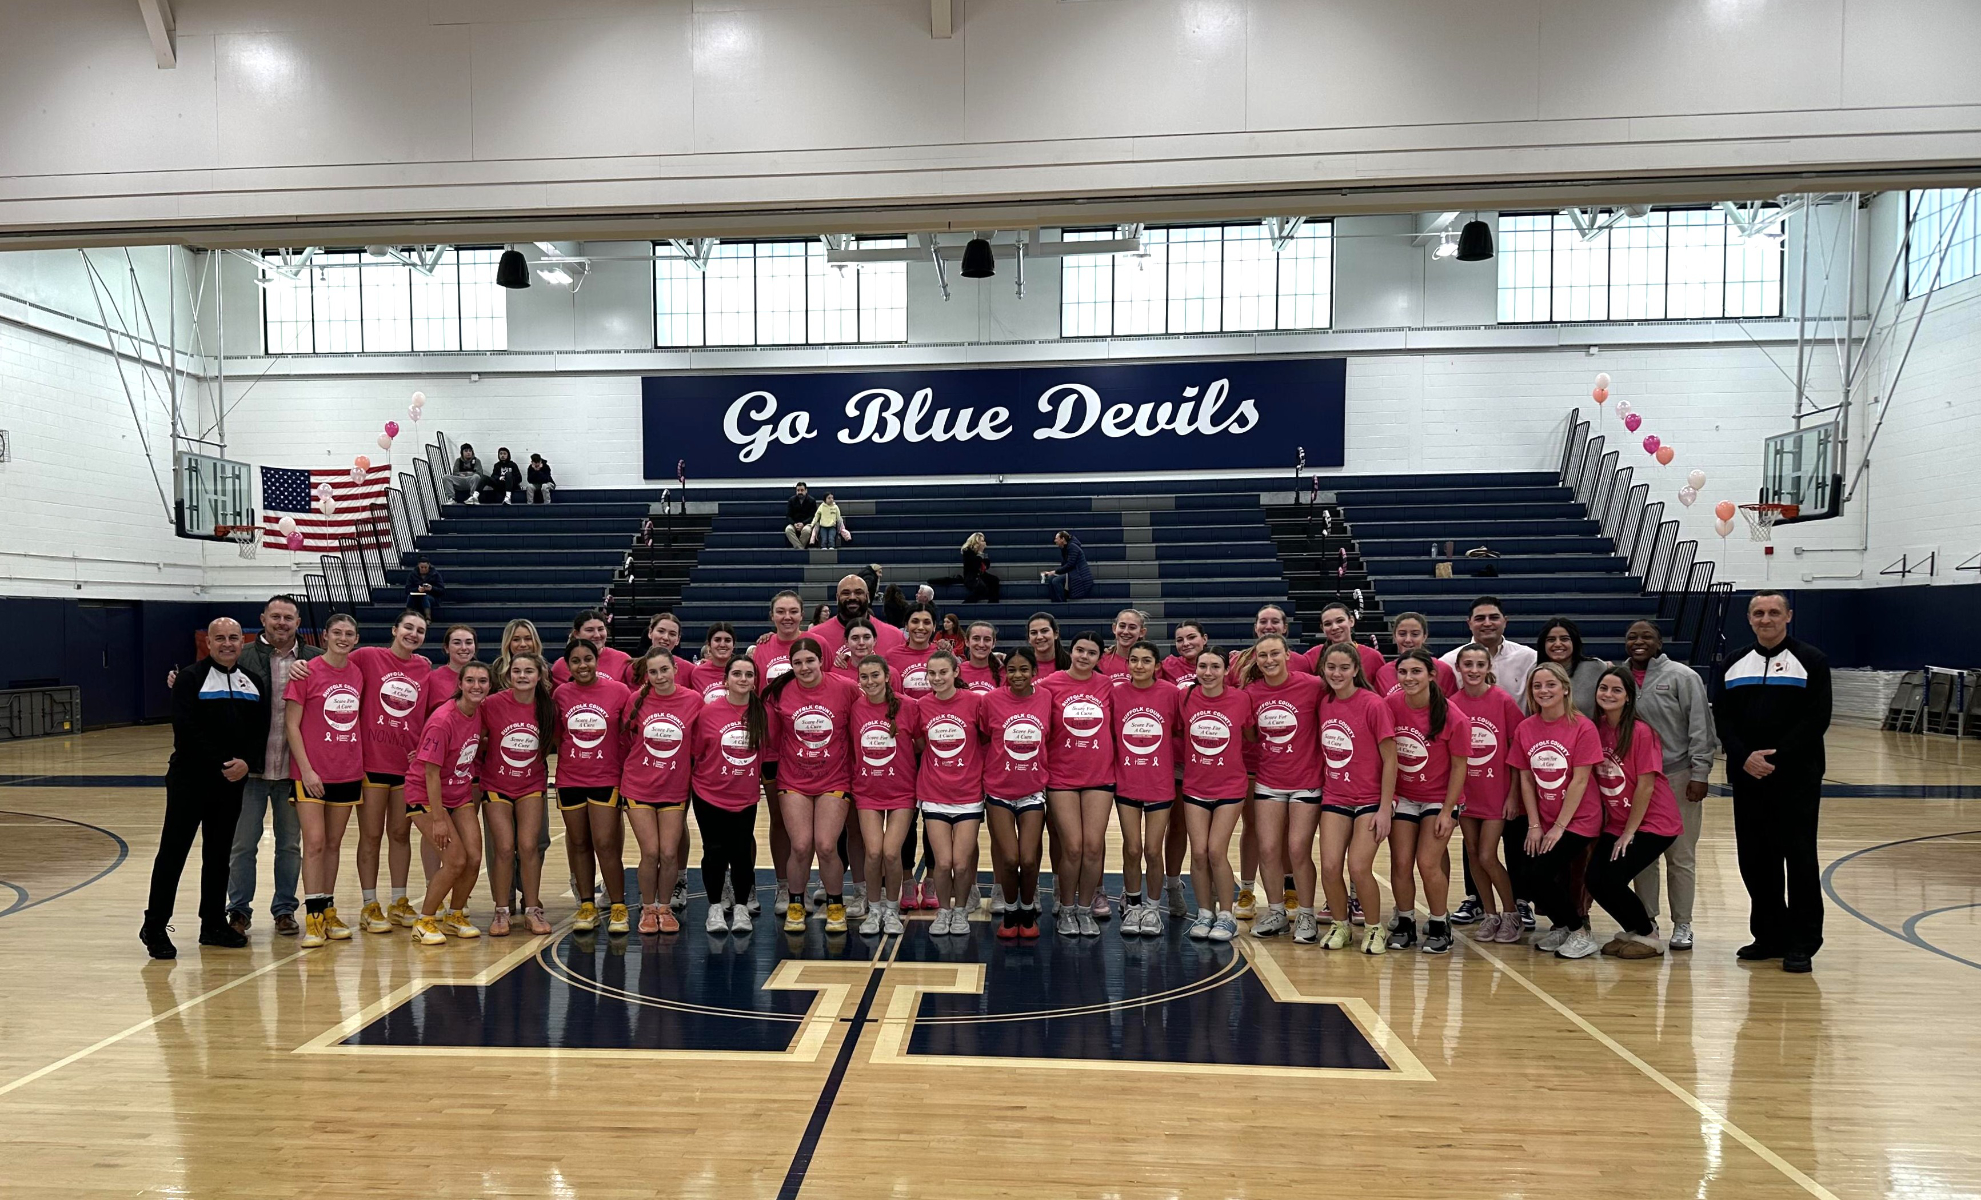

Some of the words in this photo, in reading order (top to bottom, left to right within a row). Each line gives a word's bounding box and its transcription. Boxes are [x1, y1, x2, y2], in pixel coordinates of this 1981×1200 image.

[724, 391, 817, 462] Go
[838, 389, 1012, 443] Blue
[1034, 379, 1260, 439] Devils
[901, 663, 922, 676] SUFFOLK
[565, 703, 587, 718] SUFFOLK
[588, 703, 609, 719] COUNTY
[791, 705, 813, 720] SUFFOLK
[814, 705, 835, 719] COUNTY
[1122, 707, 1143, 723] SUFFOLK
[1145, 707, 1165, 724] COUNTY
[1189, 710, 1211, 723] SUFFOLK
[1213, 710, 1233, 727] COUNTY
[642, 712, 665, 725] SUFFOLK
[666, 713, 686, 730] COUNTY
[719, 721, 742, 734] SUFFOLK
[880, 720, 891, 728] COU
[926, 714, 946, 729] SUFFOLK
[947, 714, 967, 728] COUNTY
[1002, 714, 1024, 728] SUFFOLK
[1026, 714, 1044, 730] COUNTY
[1477, 717, 1499, 734] COUNTY
[501, 723, 524, 736] SUFFOLK
[423, 737, 439, 752] 24
[1527, 740, 1550, 756] SUFFOLK
[1550, 740, 1570, 757] COUNTY
